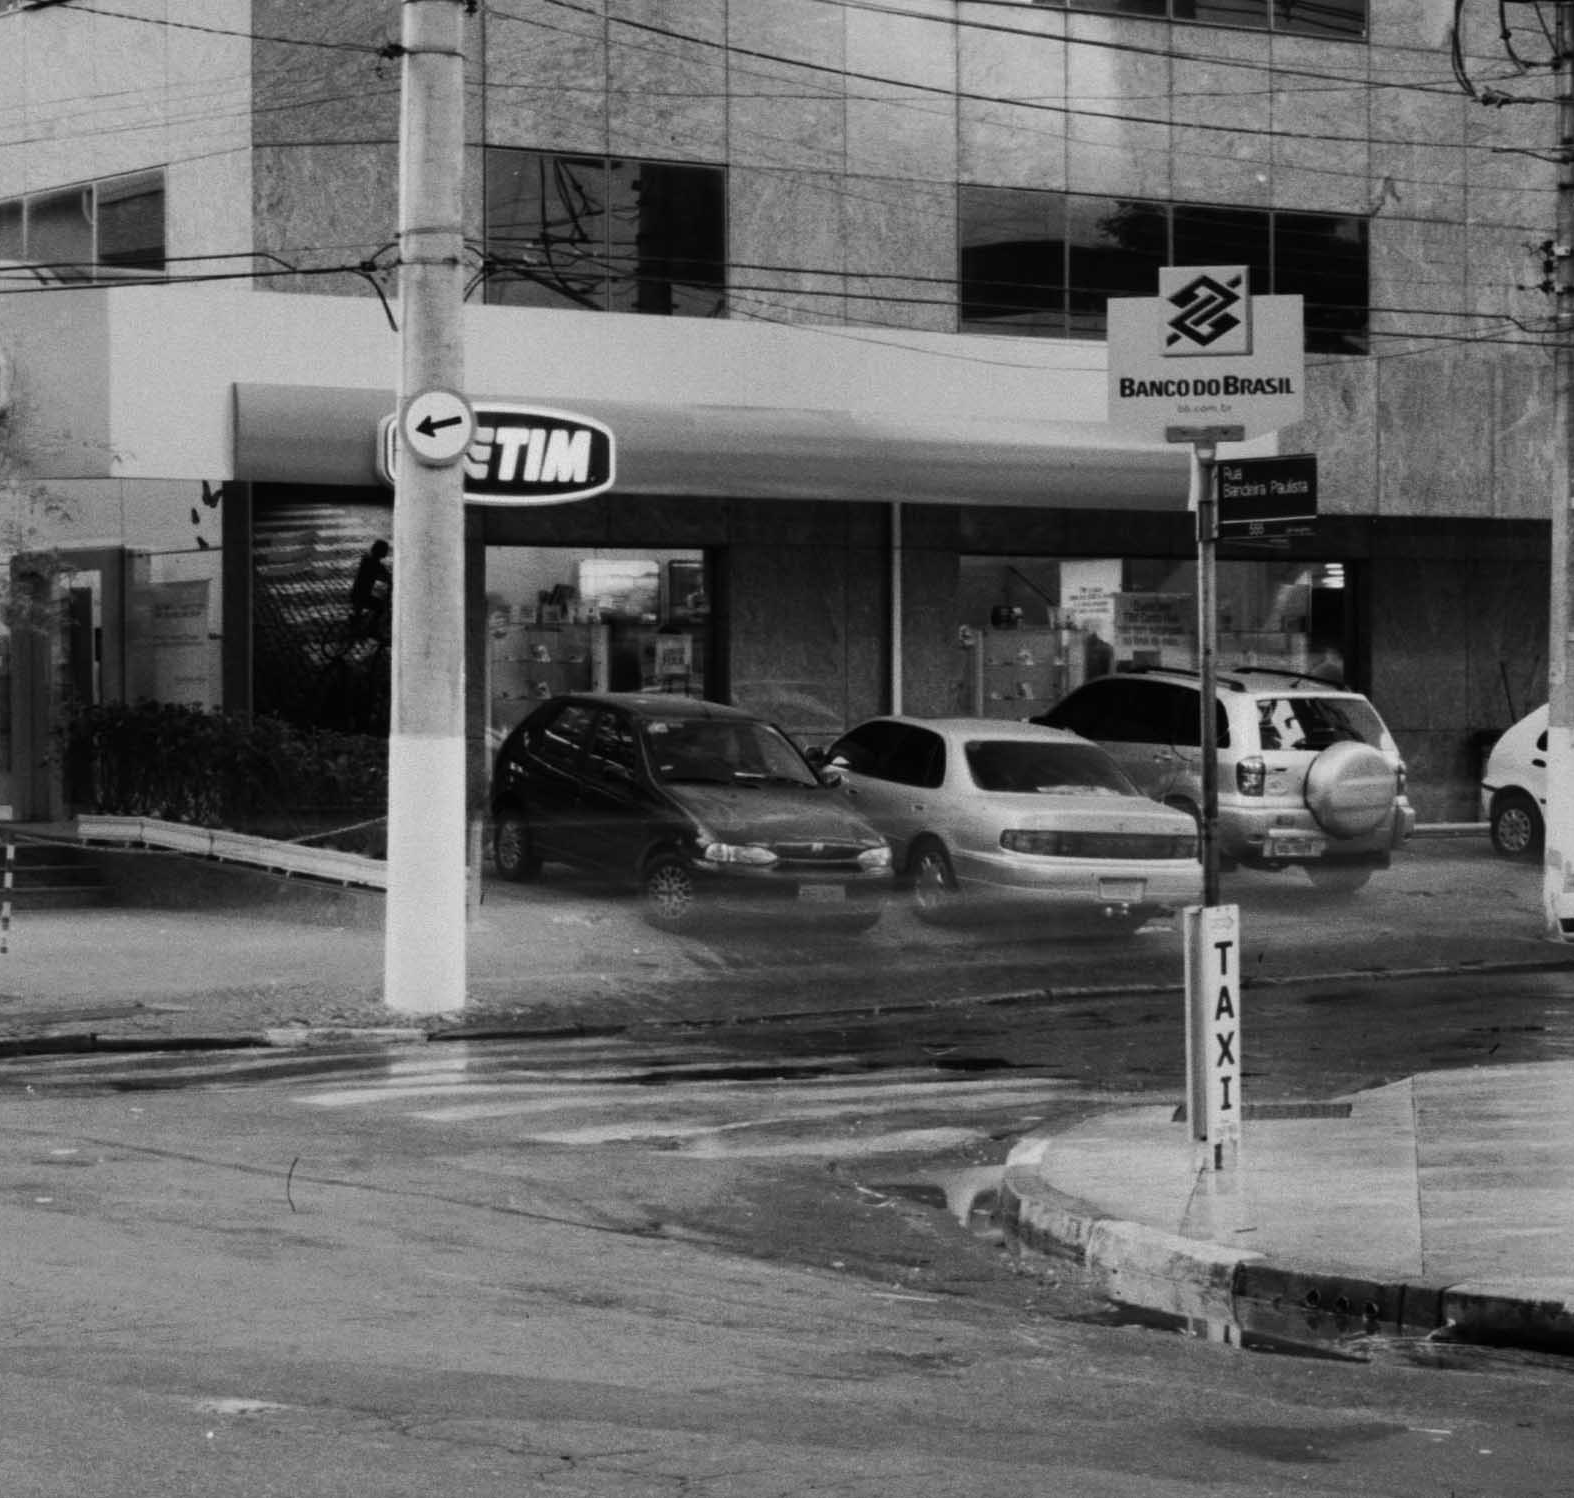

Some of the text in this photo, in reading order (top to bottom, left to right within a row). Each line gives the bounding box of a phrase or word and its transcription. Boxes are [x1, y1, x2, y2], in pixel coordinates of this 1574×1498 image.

[1120, 375, 1294, 398] BANCO DO BRASIL
[495, 427, 592, 482] TIM
[1224, 466, 1242, 481] Rua
[1224, 477, 1309, 498] Bandeira Paulista
[1214, 940, 1235, 1111] TAXI
